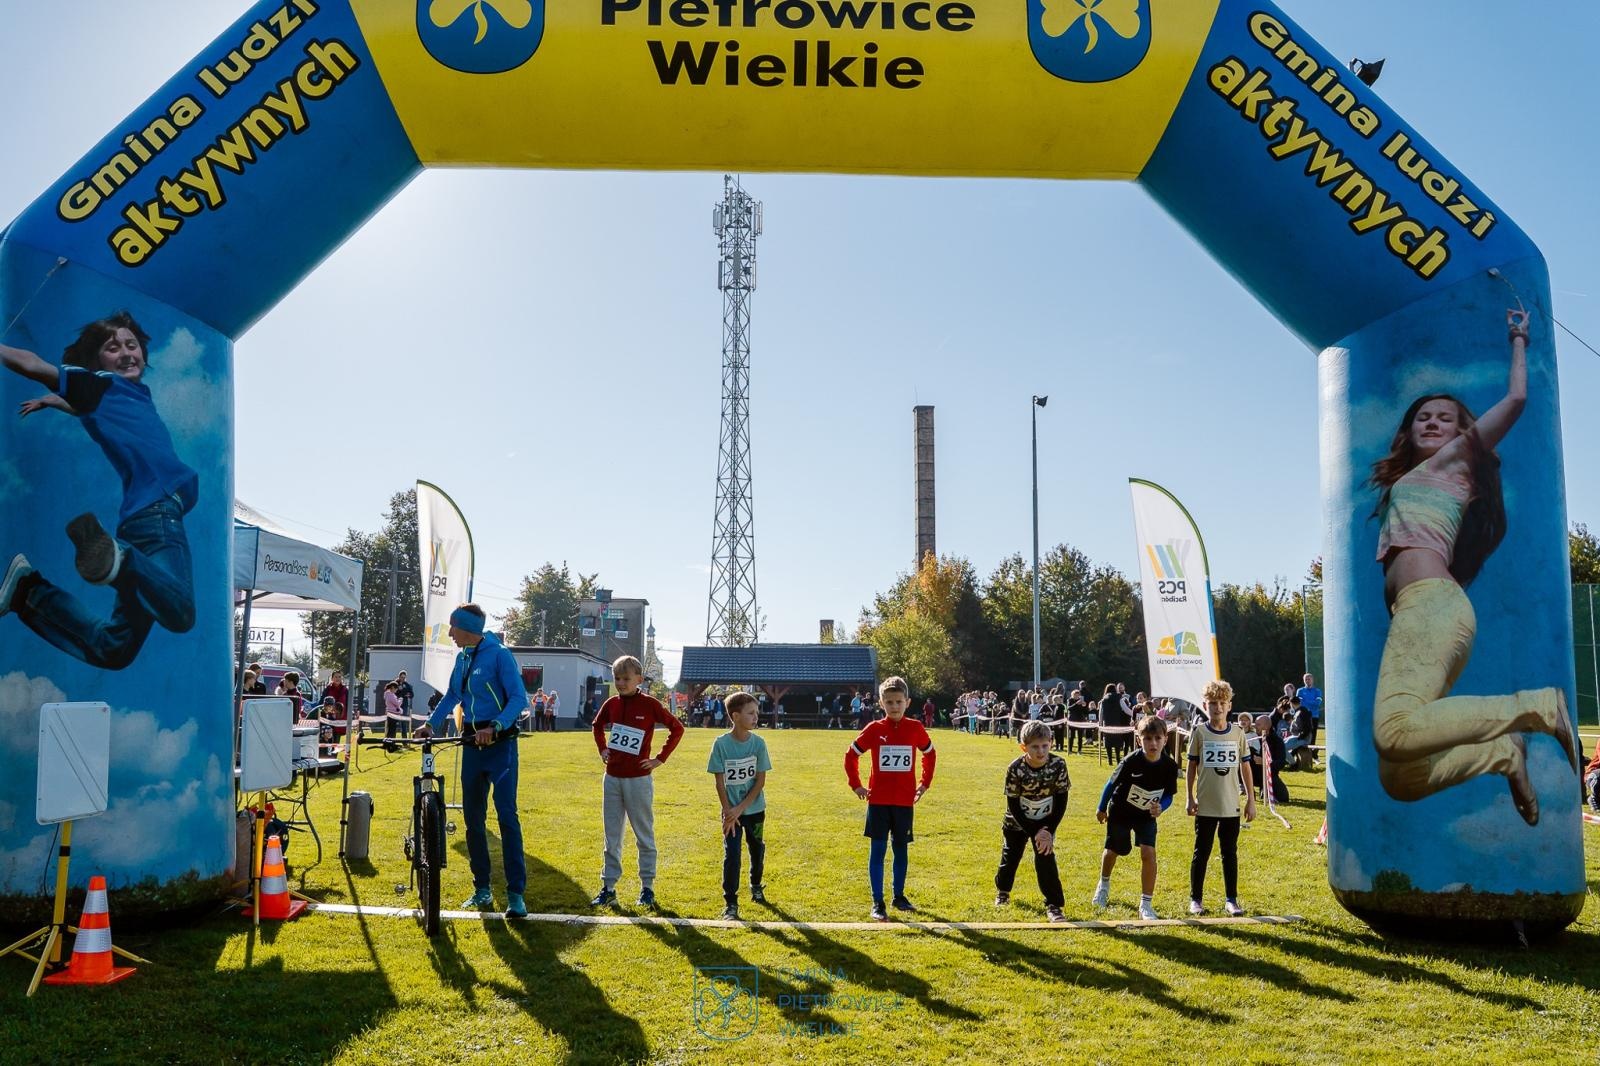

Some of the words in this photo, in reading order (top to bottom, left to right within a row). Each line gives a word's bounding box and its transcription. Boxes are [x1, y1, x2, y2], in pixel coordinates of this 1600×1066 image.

[601, 0, 975, 32] Pietrowice
[647, 40, 925, 89] Wielkie
[57, 95, 203, 221] Gmina
[198, 0, 318, 97] ludzi
[1248, 12, 1381, 138] Gmina
[1381, 132, 1496, 241] ludzi
[110, 38, 359, 265] aktywnych
[1209, 58, 1450, 279] aktywnych
[610, 732, 640, 750] 282
[881, 754, 911, 767] 278
[1205, 750, 1237, 763] 255
[727, 765, 756, 781] 256
